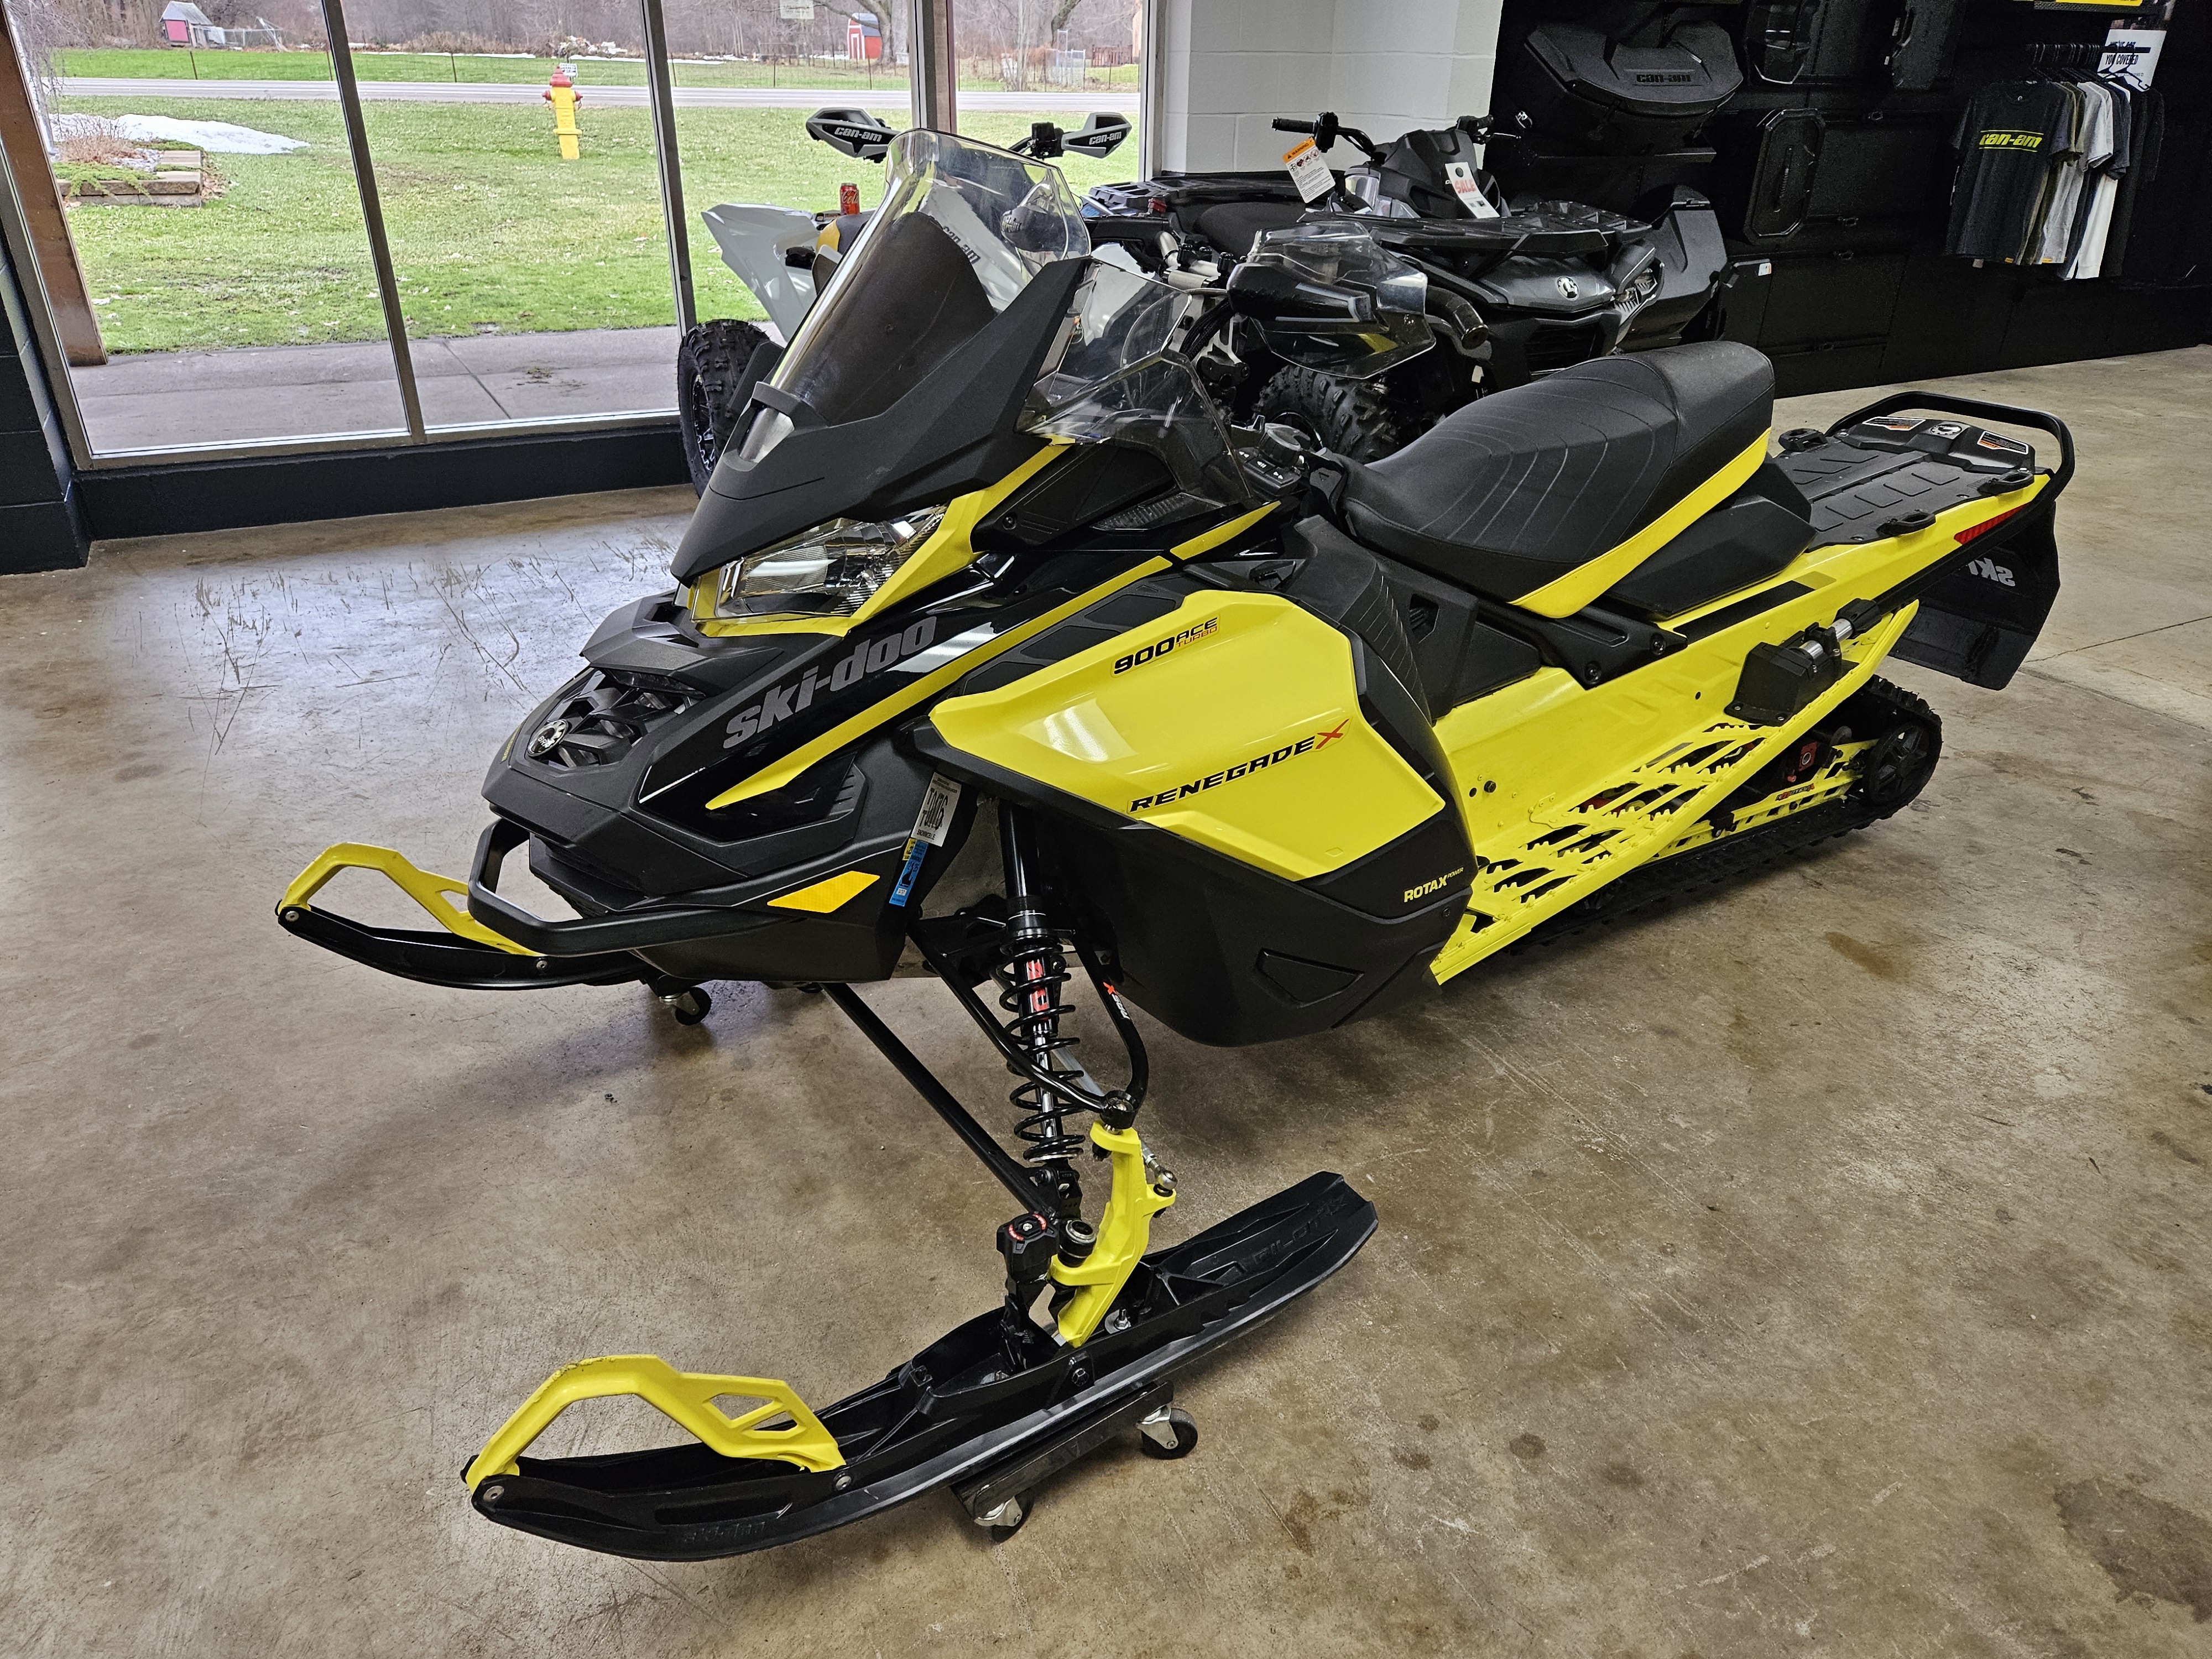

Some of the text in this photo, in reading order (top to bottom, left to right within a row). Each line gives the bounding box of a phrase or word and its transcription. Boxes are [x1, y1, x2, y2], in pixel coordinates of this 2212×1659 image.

[2105, 54, 2116, 65] YO
[1636, 74, 1691, 83] can-am
[834, 127, 882, 142] can-am
[1089, 132, 1121, 145] can-am
[1292, 143, 1309, 155] WARNING
[1454, 179, 1477, 194] SALE
[1176, 626, 1217, 648] TURBO
[1114, 617, 1217, 675] 900 ACE
[723, 616, 937, 749] ski-doo
[1130, 718, 1349, 813] RENEGADE X
[1404, 867, 1464, 902] ROTAX POWER
